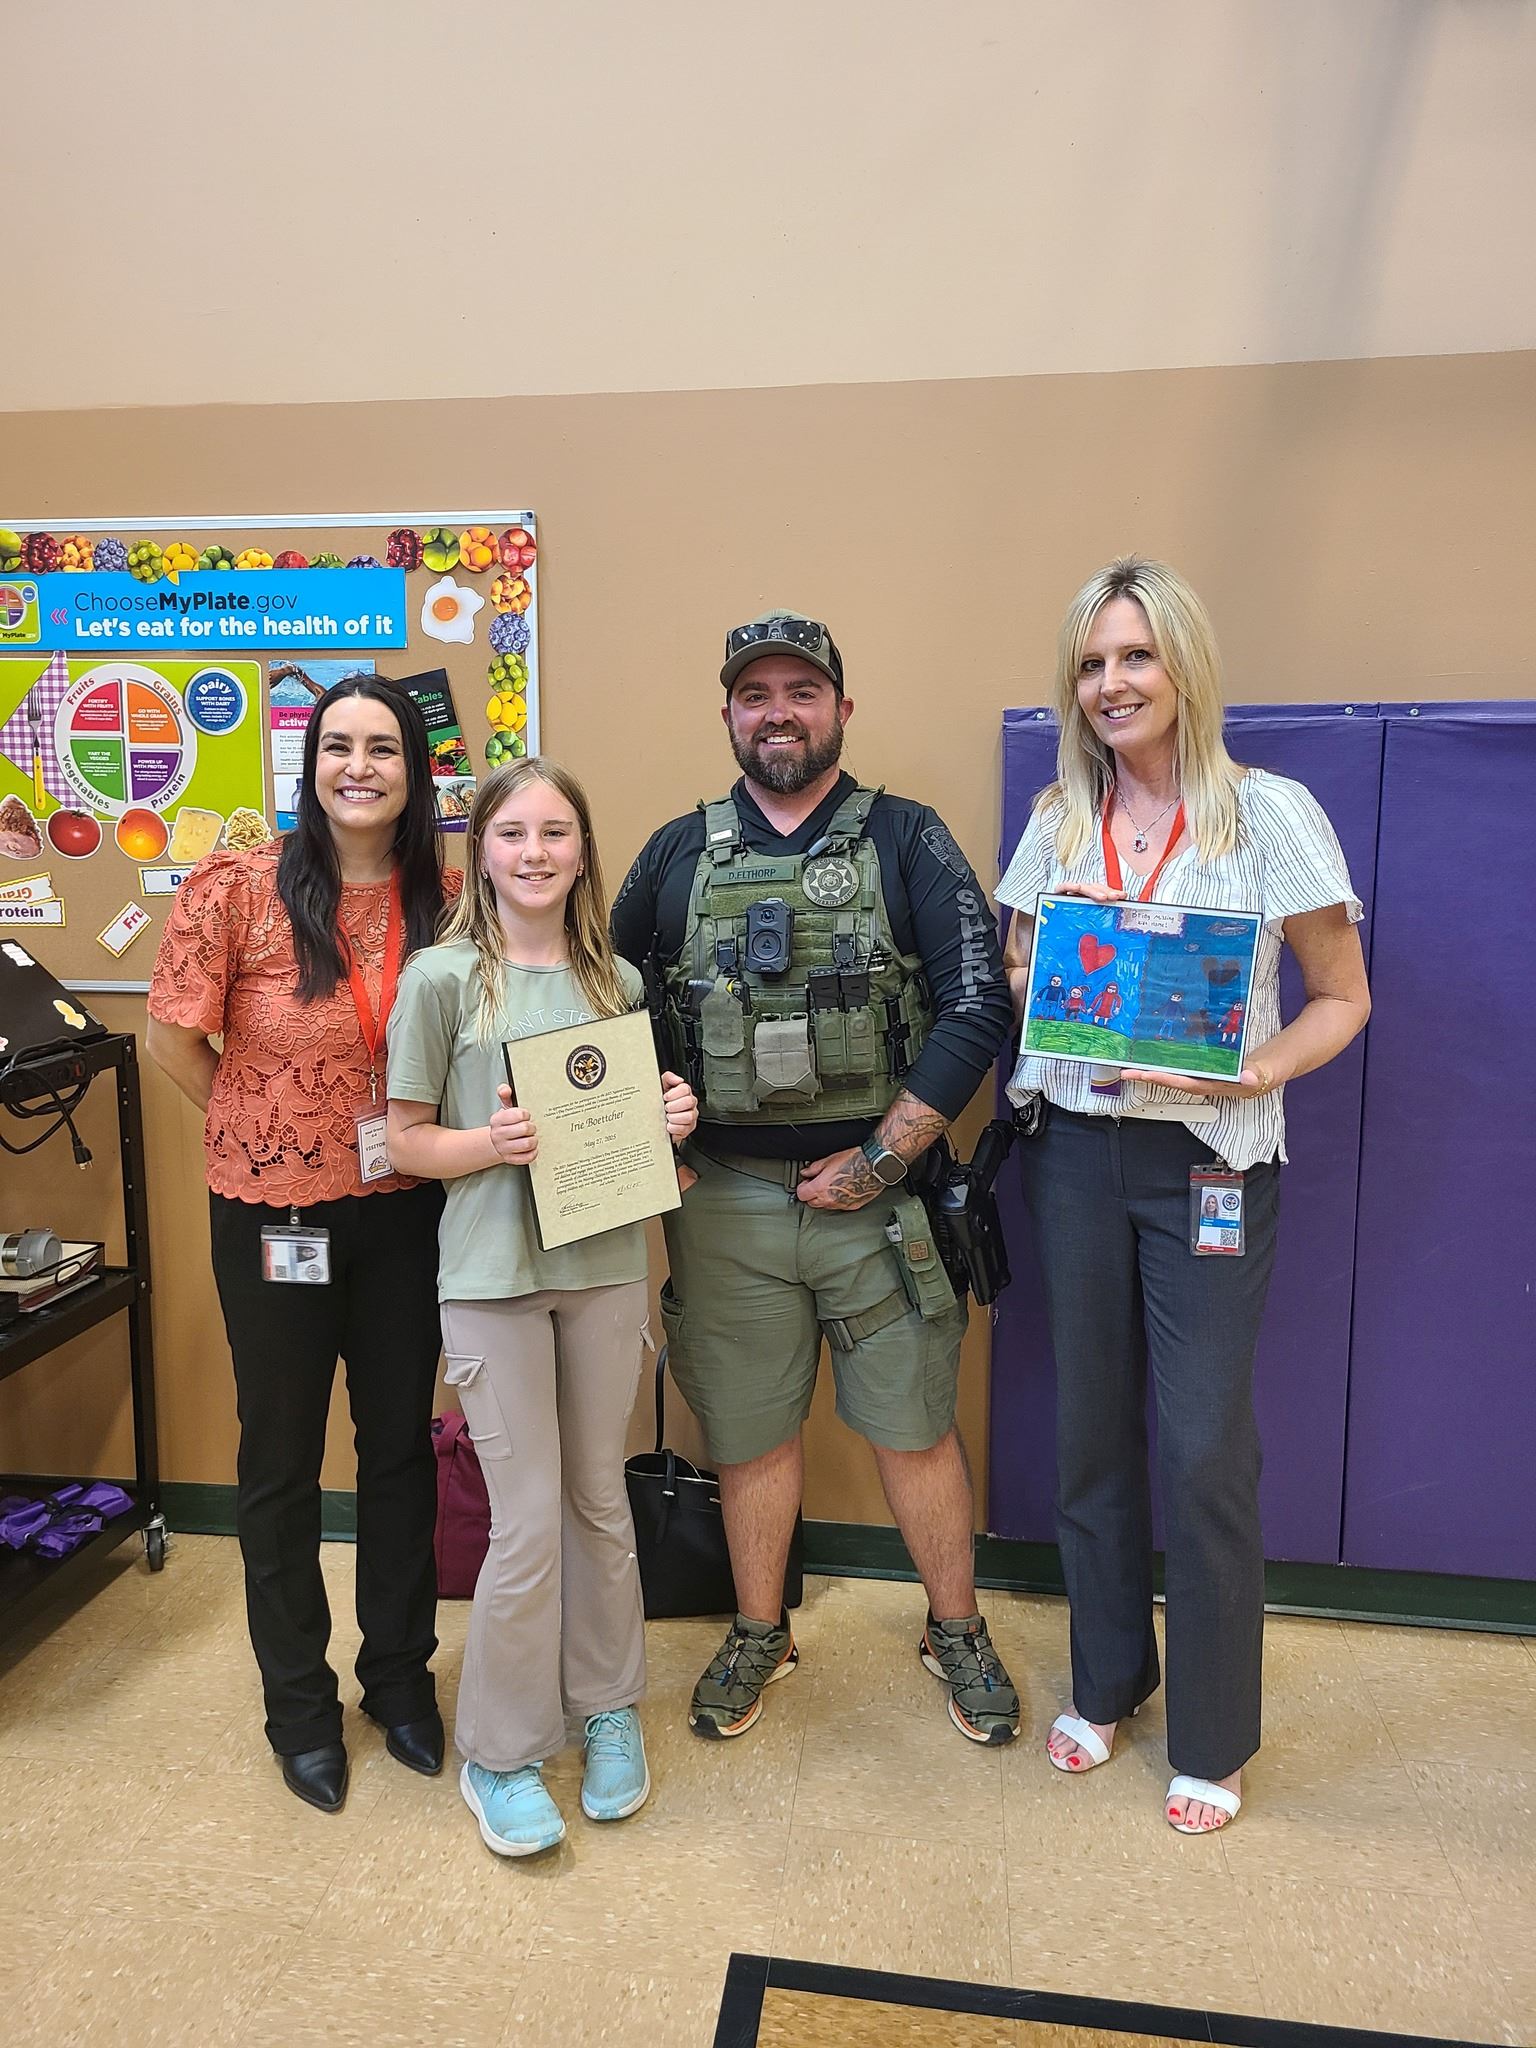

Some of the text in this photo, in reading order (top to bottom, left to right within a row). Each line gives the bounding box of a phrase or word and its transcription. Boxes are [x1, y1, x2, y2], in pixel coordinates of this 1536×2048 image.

[74, 591, 298, 614] ChooseMyPlate.gov
[75, 615, 393, 637] Let's eat for the health of it
[66, 677, 95, 705] Fruits
[153, 680, 182, 715] Grains
[198, 678, 232, 695] Dairy
[278, 718, 309, 727] active
[290, 711, 312, 719] physic
[62, 754, 110, 809] Vegetables
[151, 773, 186, 809] Protein
[585, 1110, 625, 1128] Boettcher
